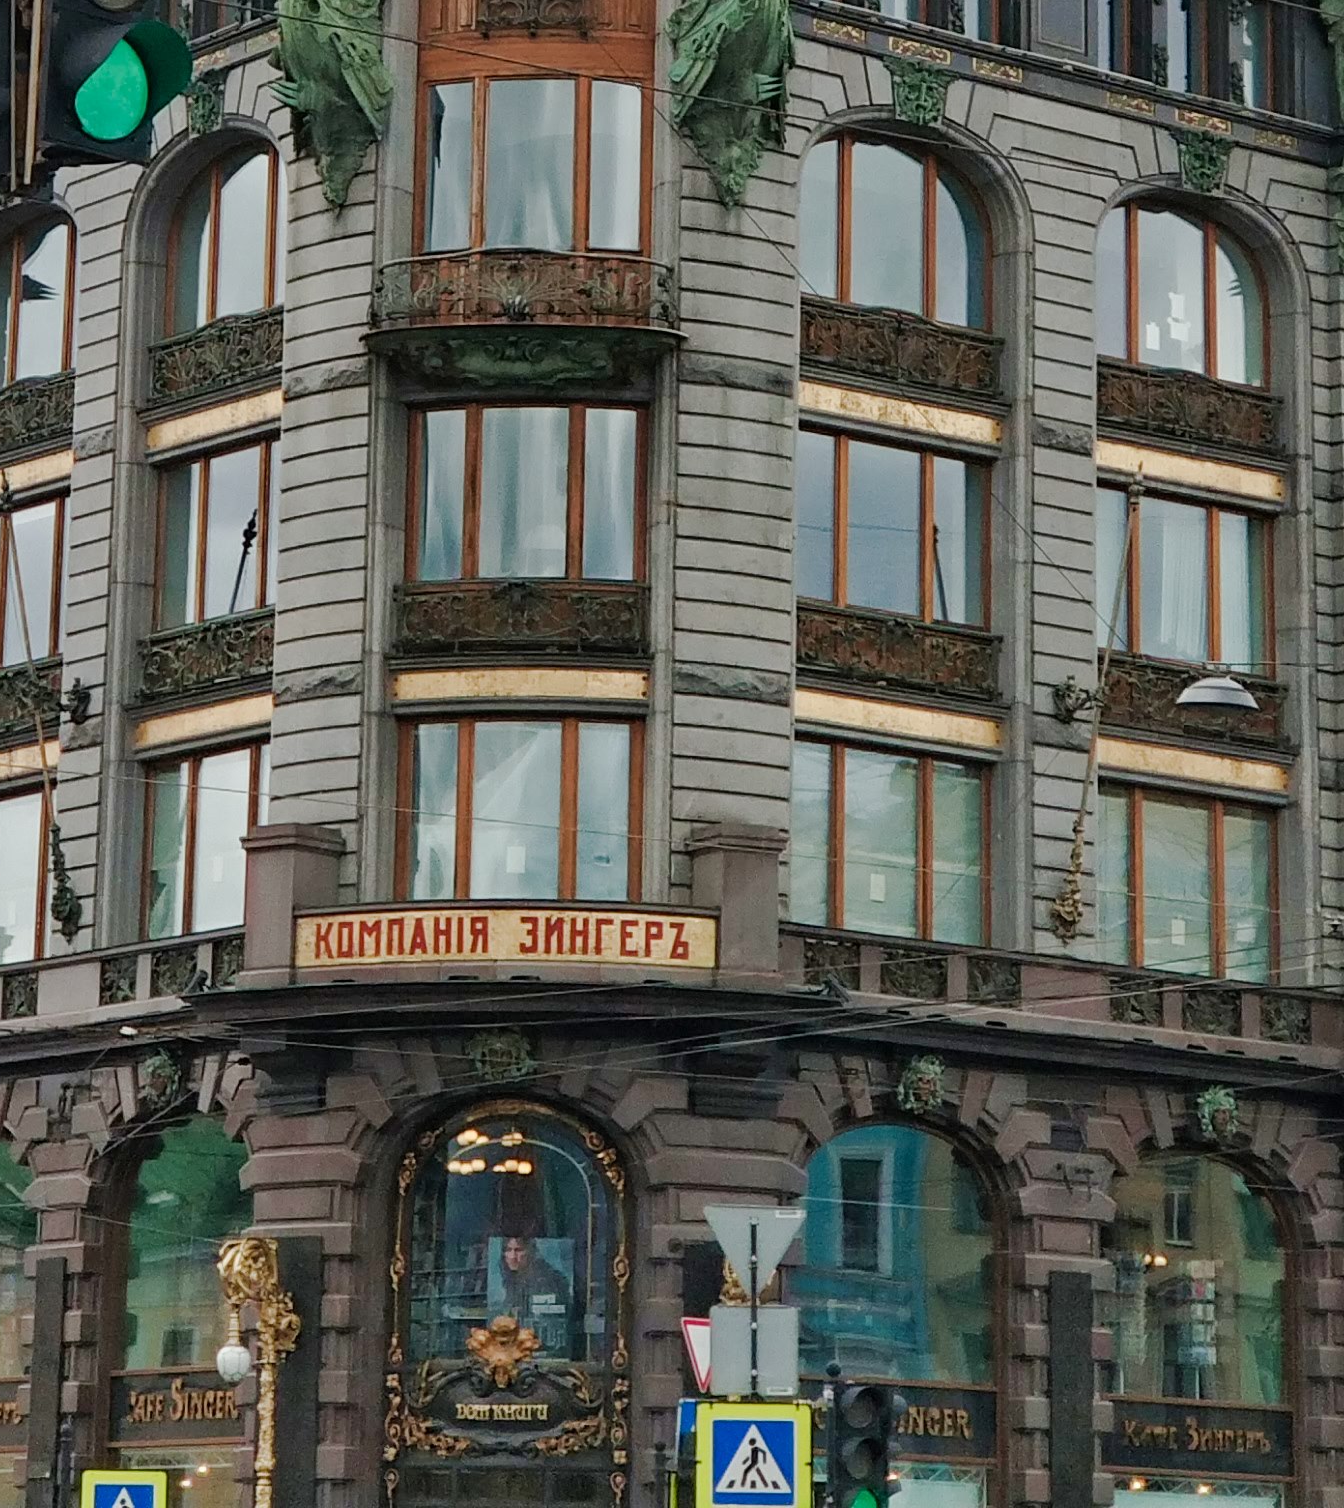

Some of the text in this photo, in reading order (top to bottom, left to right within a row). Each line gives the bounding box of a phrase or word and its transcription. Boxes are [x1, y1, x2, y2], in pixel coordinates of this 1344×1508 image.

[314, 916, 690, 960] КОМПАНІЯ ЗИНГЕРЪ
[896, 1405, 975, 1441] INGER
